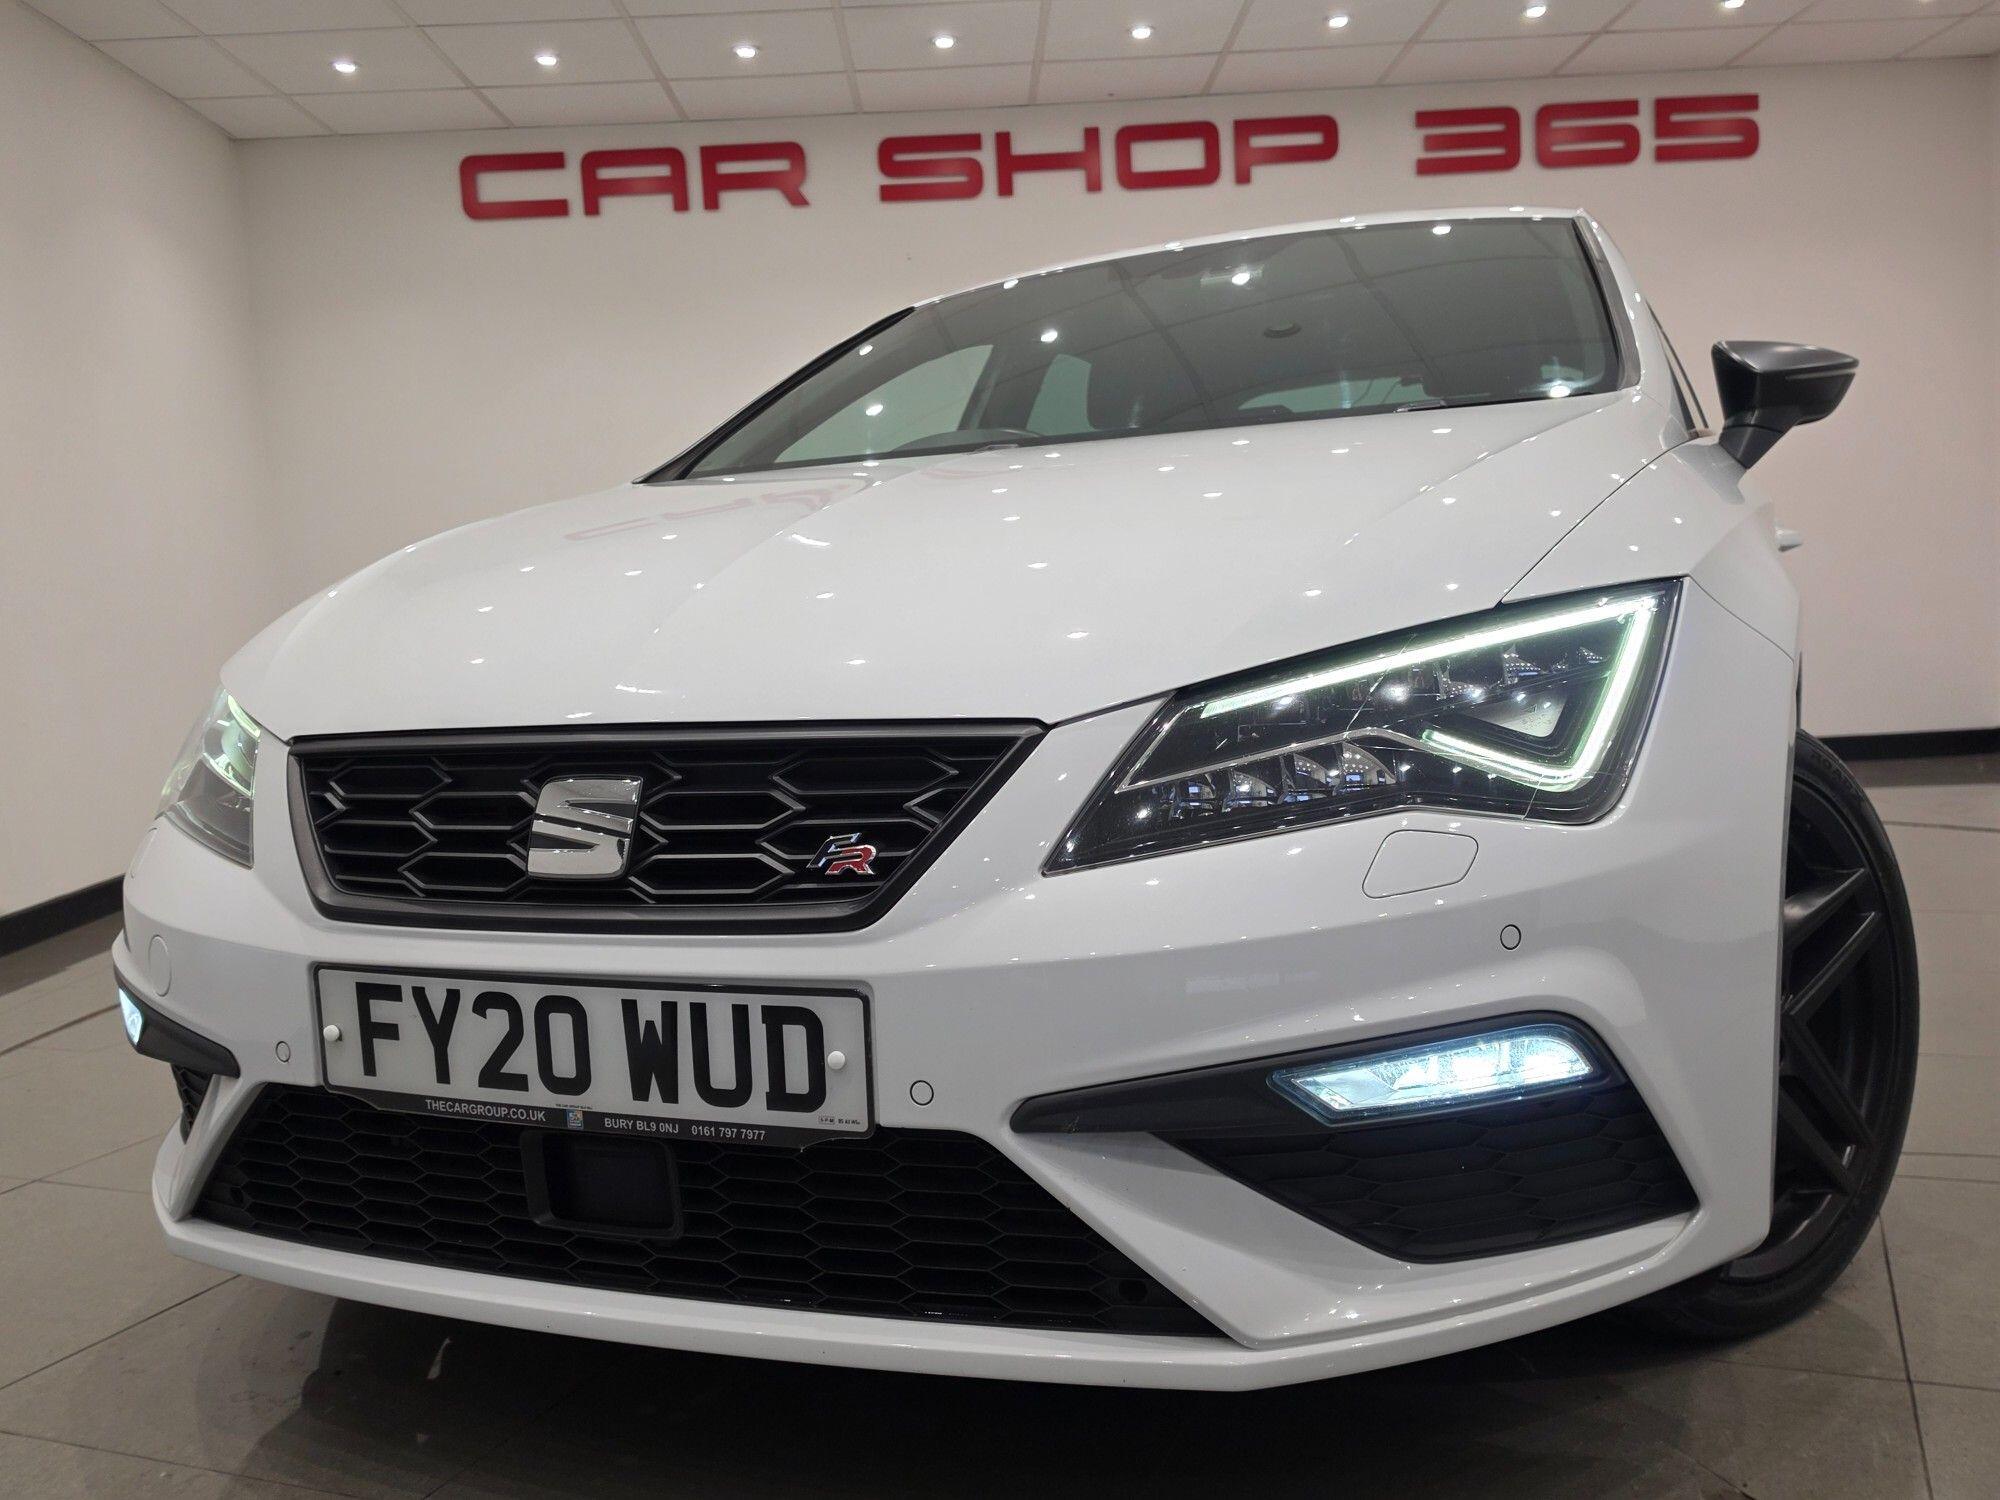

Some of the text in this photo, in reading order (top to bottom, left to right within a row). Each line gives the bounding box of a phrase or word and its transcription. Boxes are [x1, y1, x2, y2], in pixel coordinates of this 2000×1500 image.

[460, 94, 1760, 220] CAR SHOP 365
[806, 832, 877, 876] FR
[355, 981, 828, 1114] FY20 WUD
[425, 1099, 546, 1122] THECARGROUP.CO.UK
[604, 1117, 634, 1131] BURY
[636, 1121, 657, 1133] BL9
[691, 1125, 716, 1138] 0161
[718, 1127, 738, 1140] 797
[740, 1129, 767, 1142] 7977
